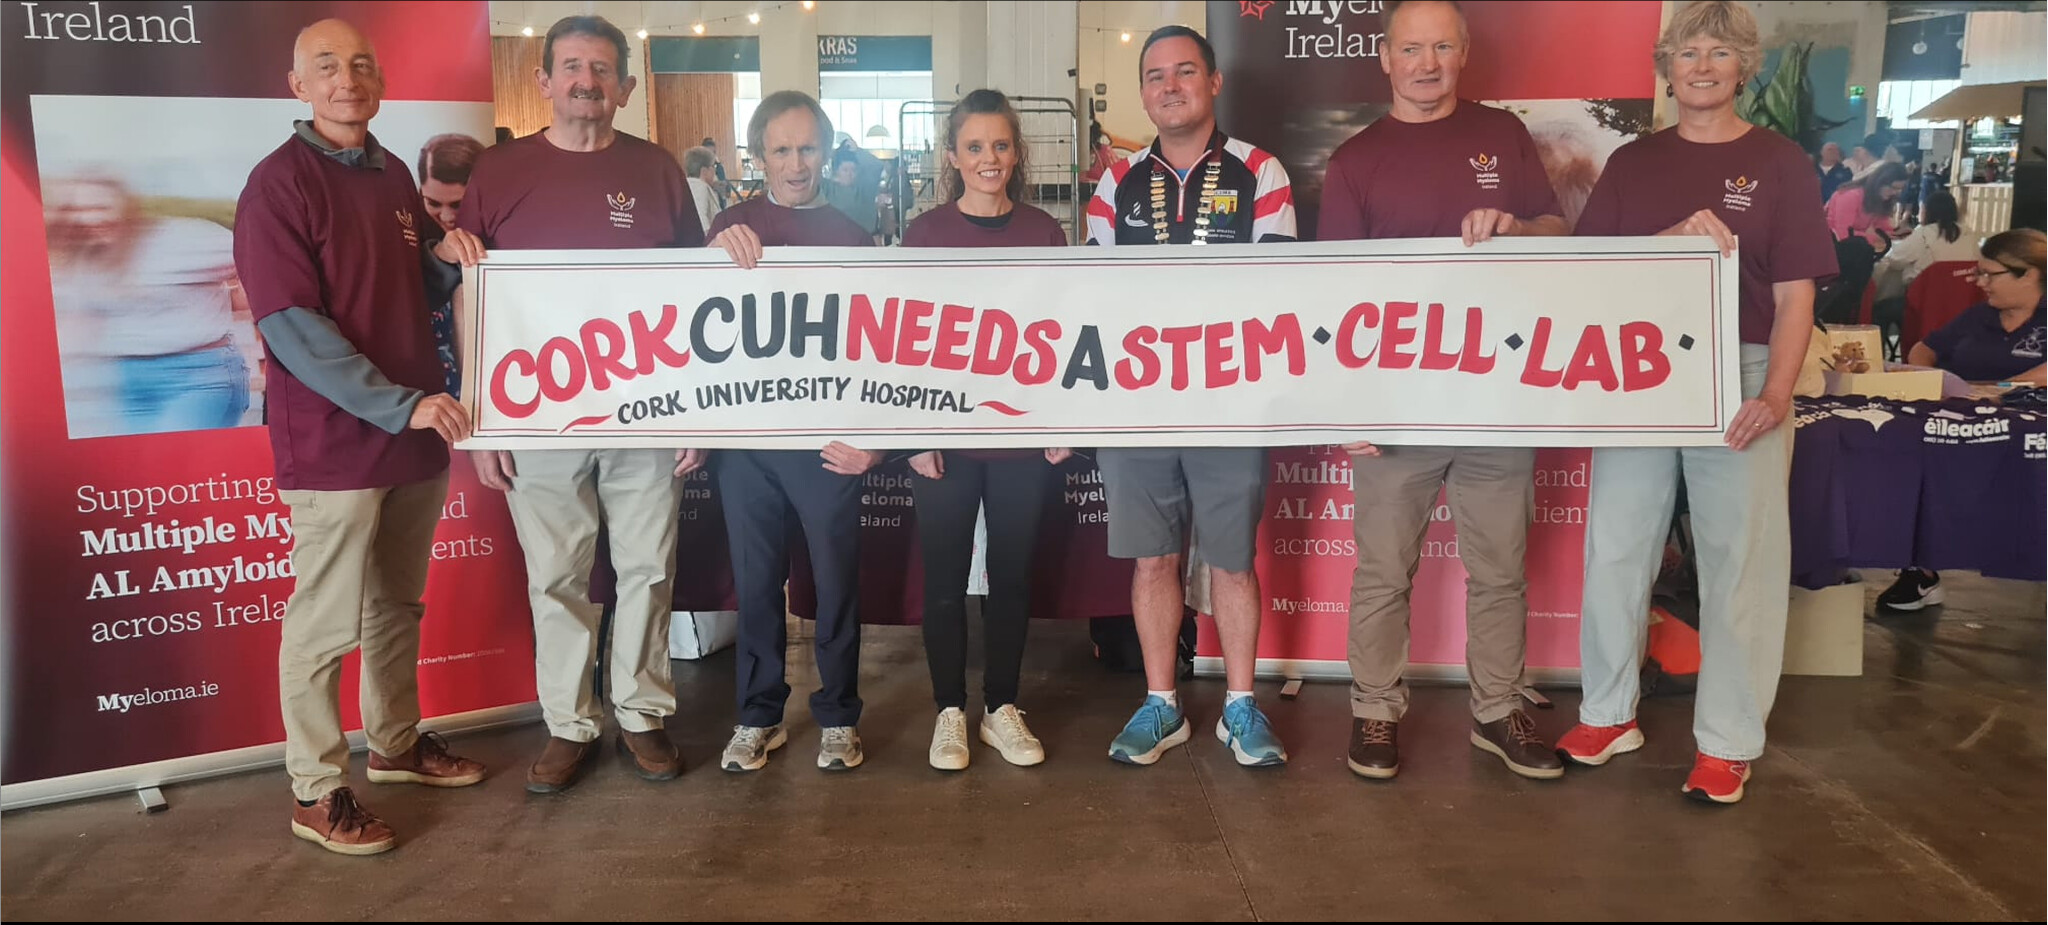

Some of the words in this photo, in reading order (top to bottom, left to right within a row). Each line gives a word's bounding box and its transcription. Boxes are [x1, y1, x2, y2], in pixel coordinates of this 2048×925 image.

[21, 1, 201, 44] Ireland
[1285, 24, 1384, 58] Irela
[490, 304, 690, 418] CORK
[690, 291, 840, 364] CUH
[846, 294, 1062, 386] NEEDS
[1061, 325, 1109, 391] A
[1114, 313, 1306, 391] STEM
[1335, 301, 1498, 375] CELL
[1520, 316, 1672, 392] LAB
[617, 390, 687, 425] CORK
[696, 377, 851, 411] UNIVERSITY
[861, 378, 975, 414] HOSPITAL
[862, 472, 913, 491] ltiple
[1065, 469, 1104, 486] Mult
[1275, 460, 1355, 491] Multi
[1535, 463, 1588, 488] and
[77, 473, 275, 517] Supporting
[861, 491, 914, 507] eloma
[1064, 487, 1105, 506] Myel
[860, 514, 901, 527] eland
[1078, 510, 1109, 524] Irela
[1274, 499, 1313, 520] AL
[80, 517, 236, 557] Multiple
[431, 534, 494, 560] ents
[1274, 537, 1355, 556] across
[86, 569, 140, 600] AL
[149, 552, 298, 594] Amyloid
[92, 610, 202, 643] across
[212, 594, 288, 628] Irela
[1271, 597, 1349, 615] Myeloma.
[97, 680, 219, 713] Myeloma.ie
